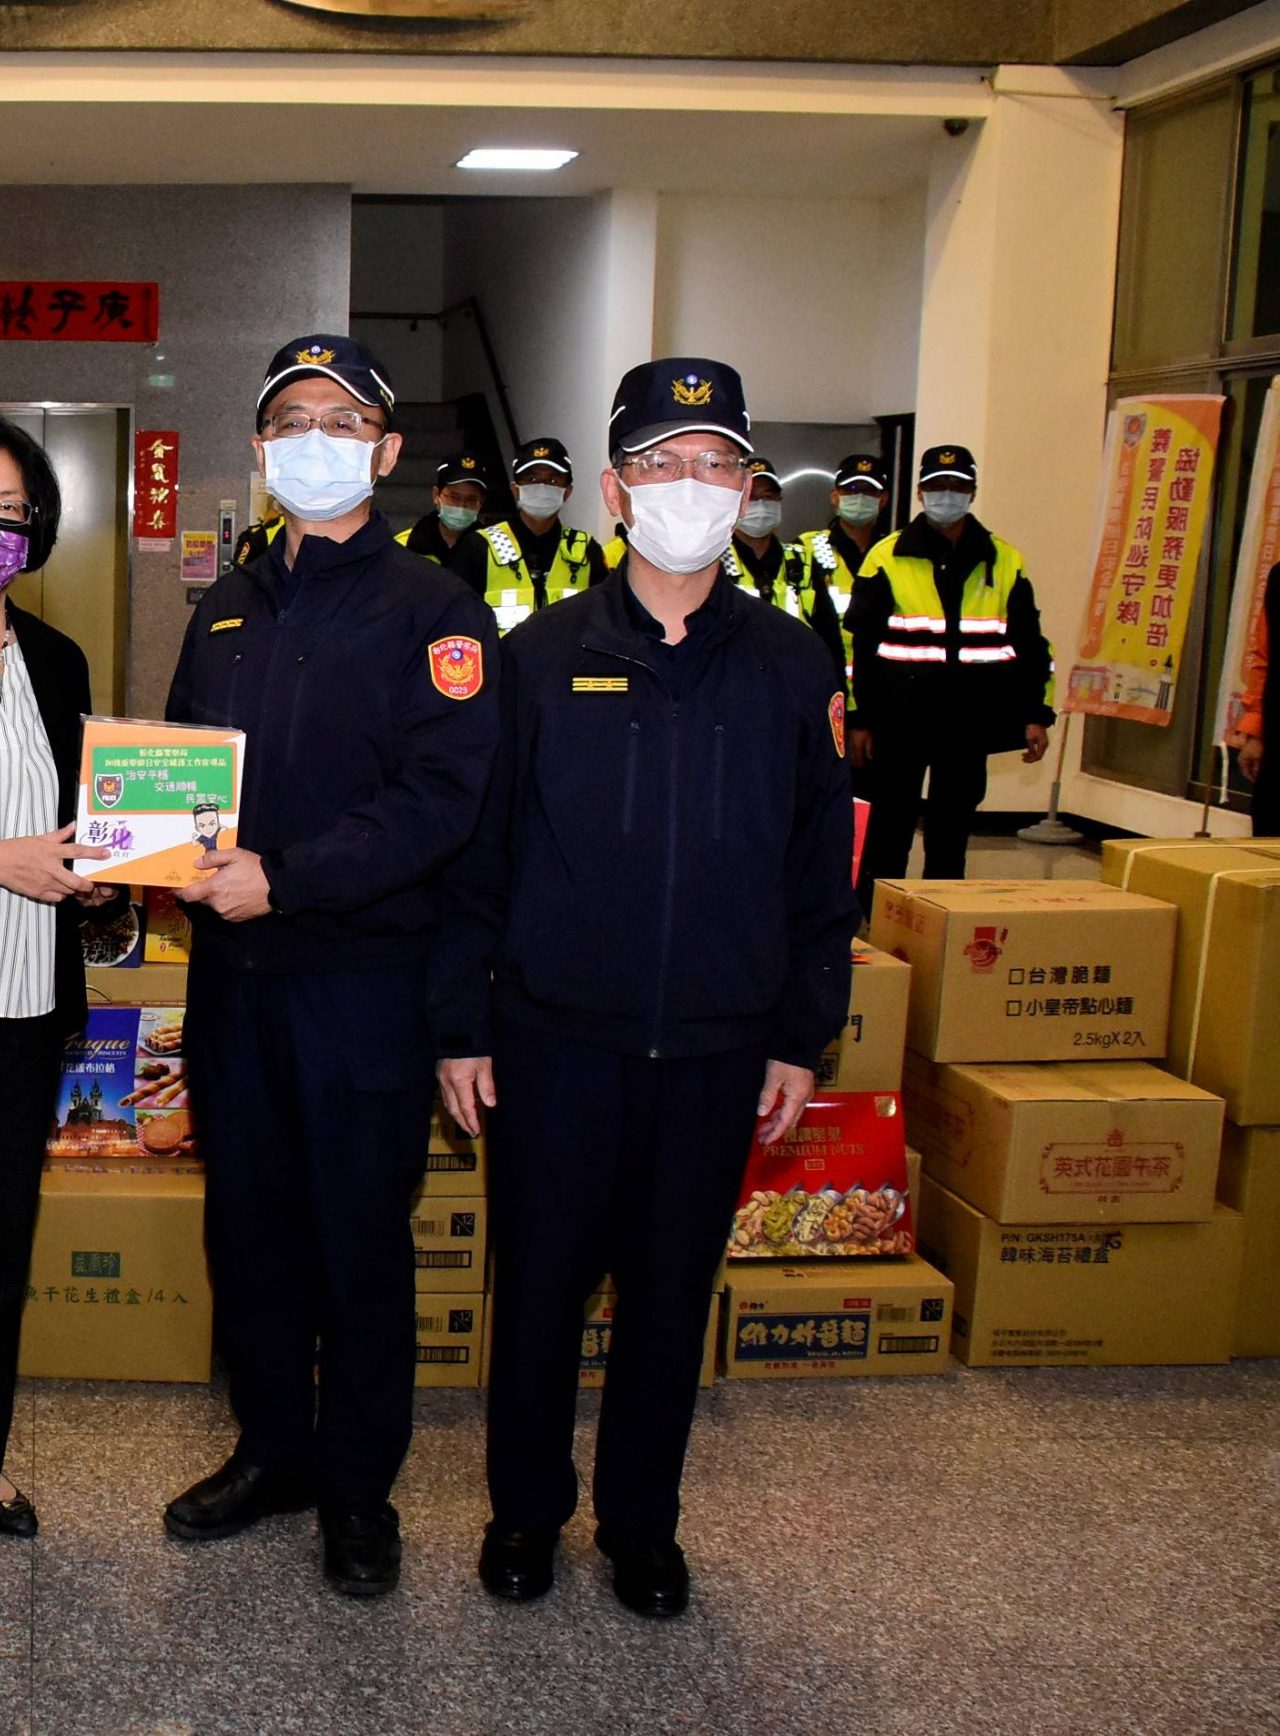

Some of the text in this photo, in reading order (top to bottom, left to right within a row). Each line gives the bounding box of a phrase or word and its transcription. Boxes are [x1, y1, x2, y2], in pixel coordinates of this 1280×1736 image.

[1028, 965, 1111, 985] 台灣脆麵
[1025, 997, 1134, 1017] 小皇帝點心麵
[1053, 1155, 1171, 1178] 英式花園午茶
[999, 1246, 1110, 1264] 韓味海苔禮盒
[740, 1318, 867, 1349] 維力炸醬麵
